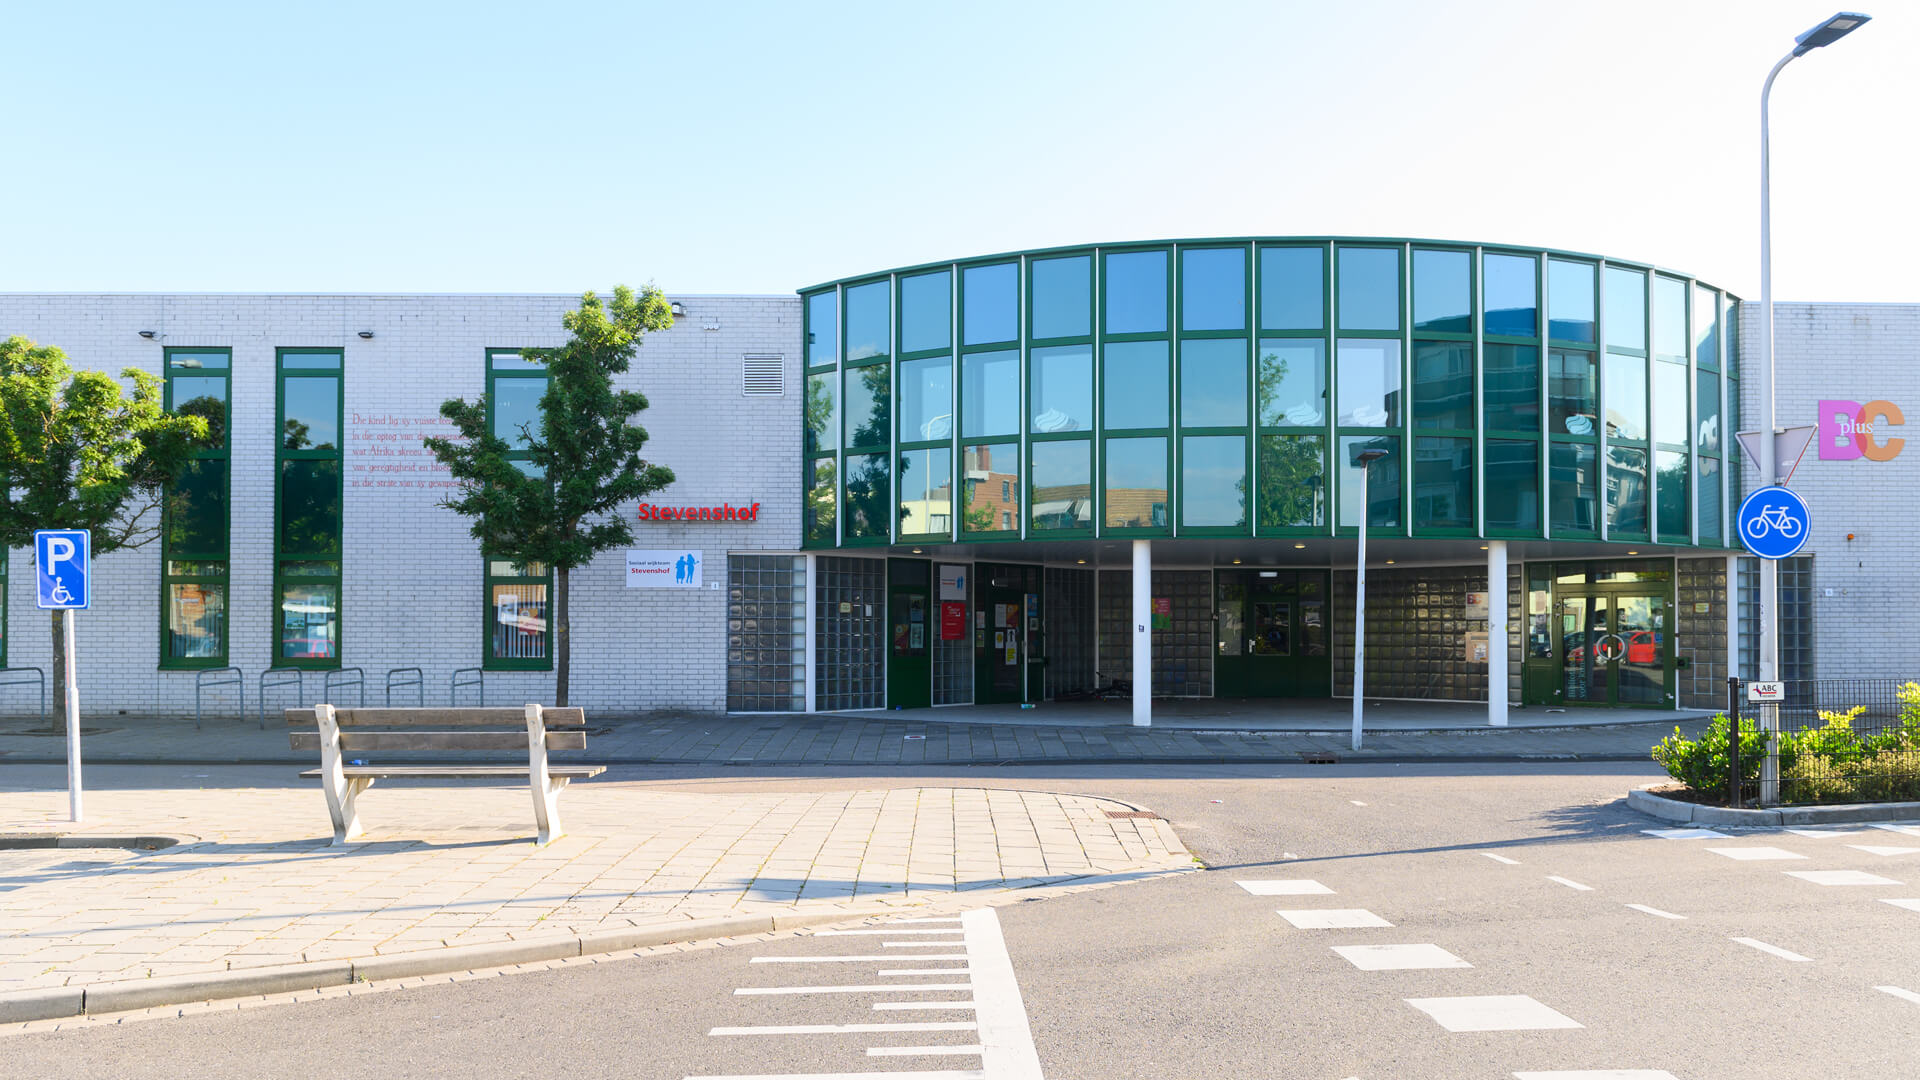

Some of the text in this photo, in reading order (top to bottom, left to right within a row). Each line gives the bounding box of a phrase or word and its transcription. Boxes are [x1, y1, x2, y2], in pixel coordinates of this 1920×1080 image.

[353, 413, 366, 424] Die
[369, 415, 385, 424] kind
[389, 415, 398, 427] lig
[1839, 419, 1873, 436] plus
[362, 430, 373, 440] die
[352, 448, 366, 456] wat
[369, 444, 394, 456] Afrika
[362, 475, 373, 487] die
[638, 502, 760, 520] Stevenshof
[47, 538, 75, 575] P
